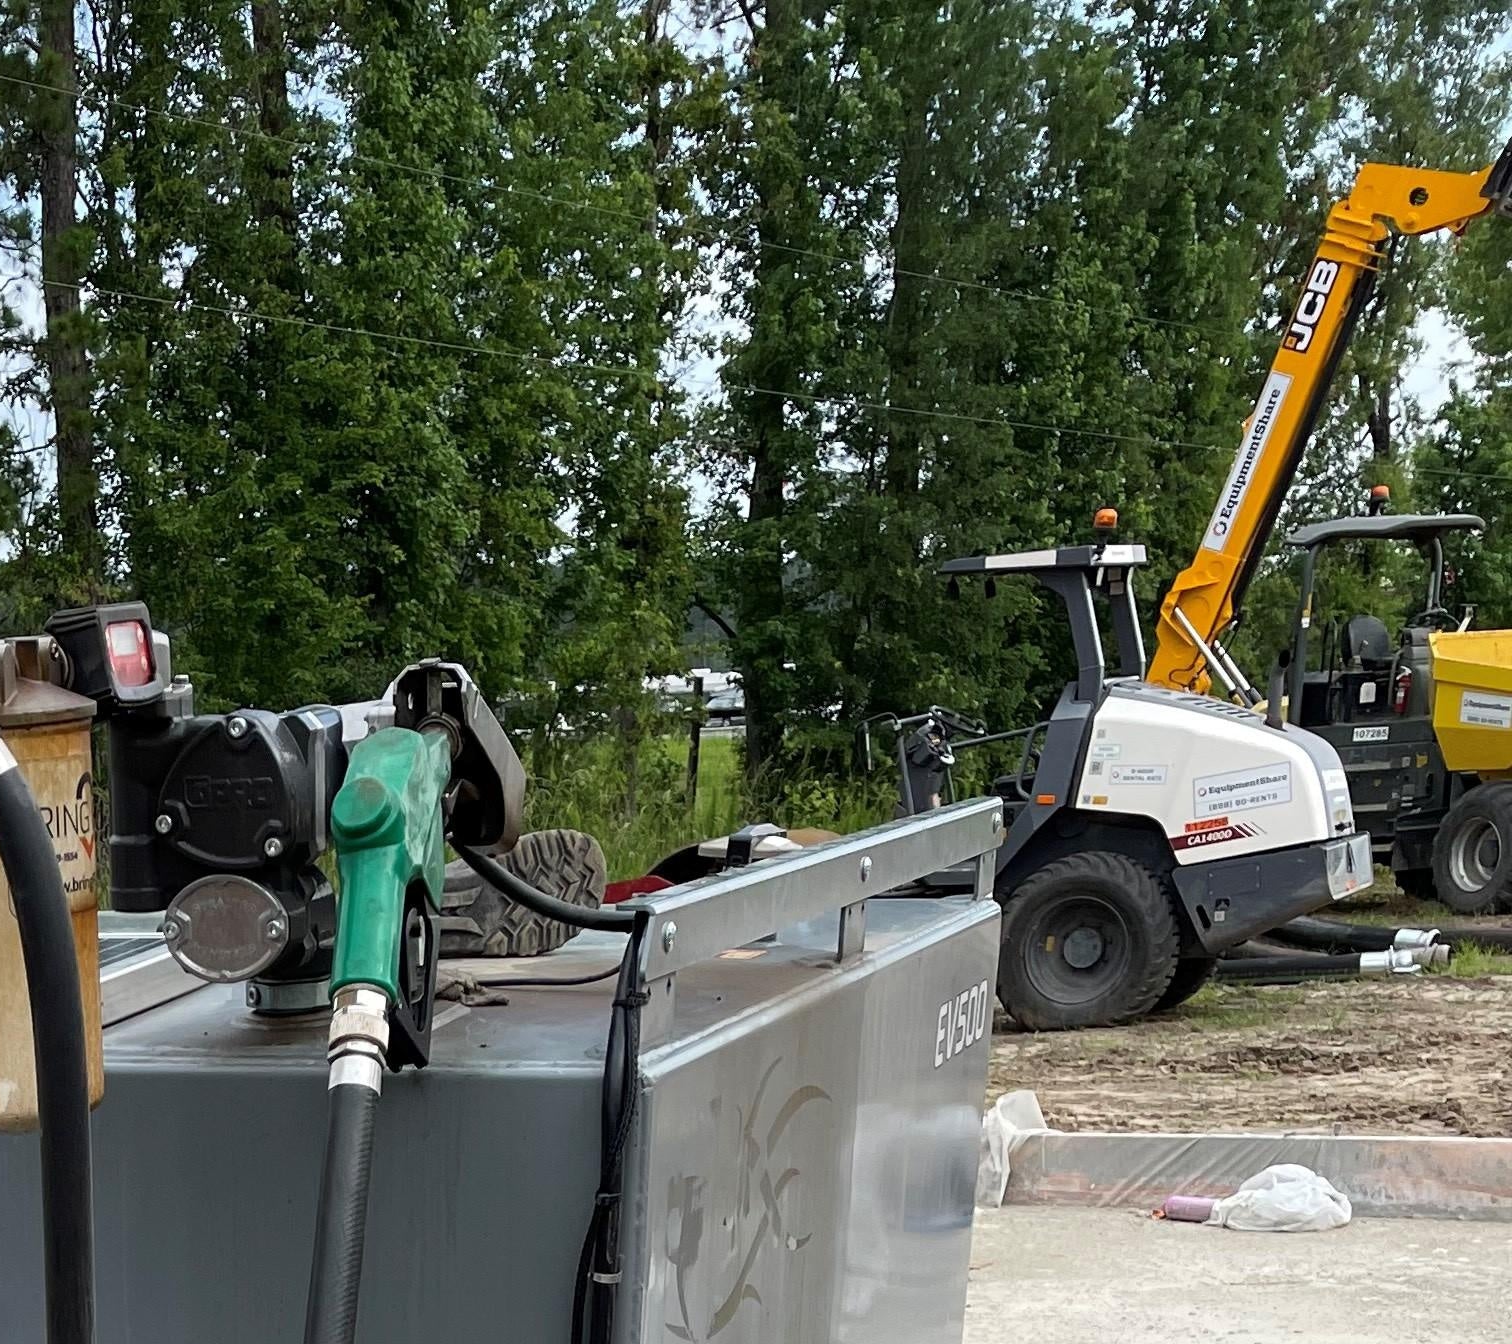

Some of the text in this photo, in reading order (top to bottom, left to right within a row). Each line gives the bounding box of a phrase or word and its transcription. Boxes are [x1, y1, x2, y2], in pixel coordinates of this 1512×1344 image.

[1290, 260, 1338, 351] JCB
[1219, 388, 1281, 521] EquipmentShare
[1354, 728, 1388, 739] 107285
[1208, 773, 1288, 795] EquipmentShare
[39, 799, 90, 839] RING
[934, 979, 988, 1068] EV500
